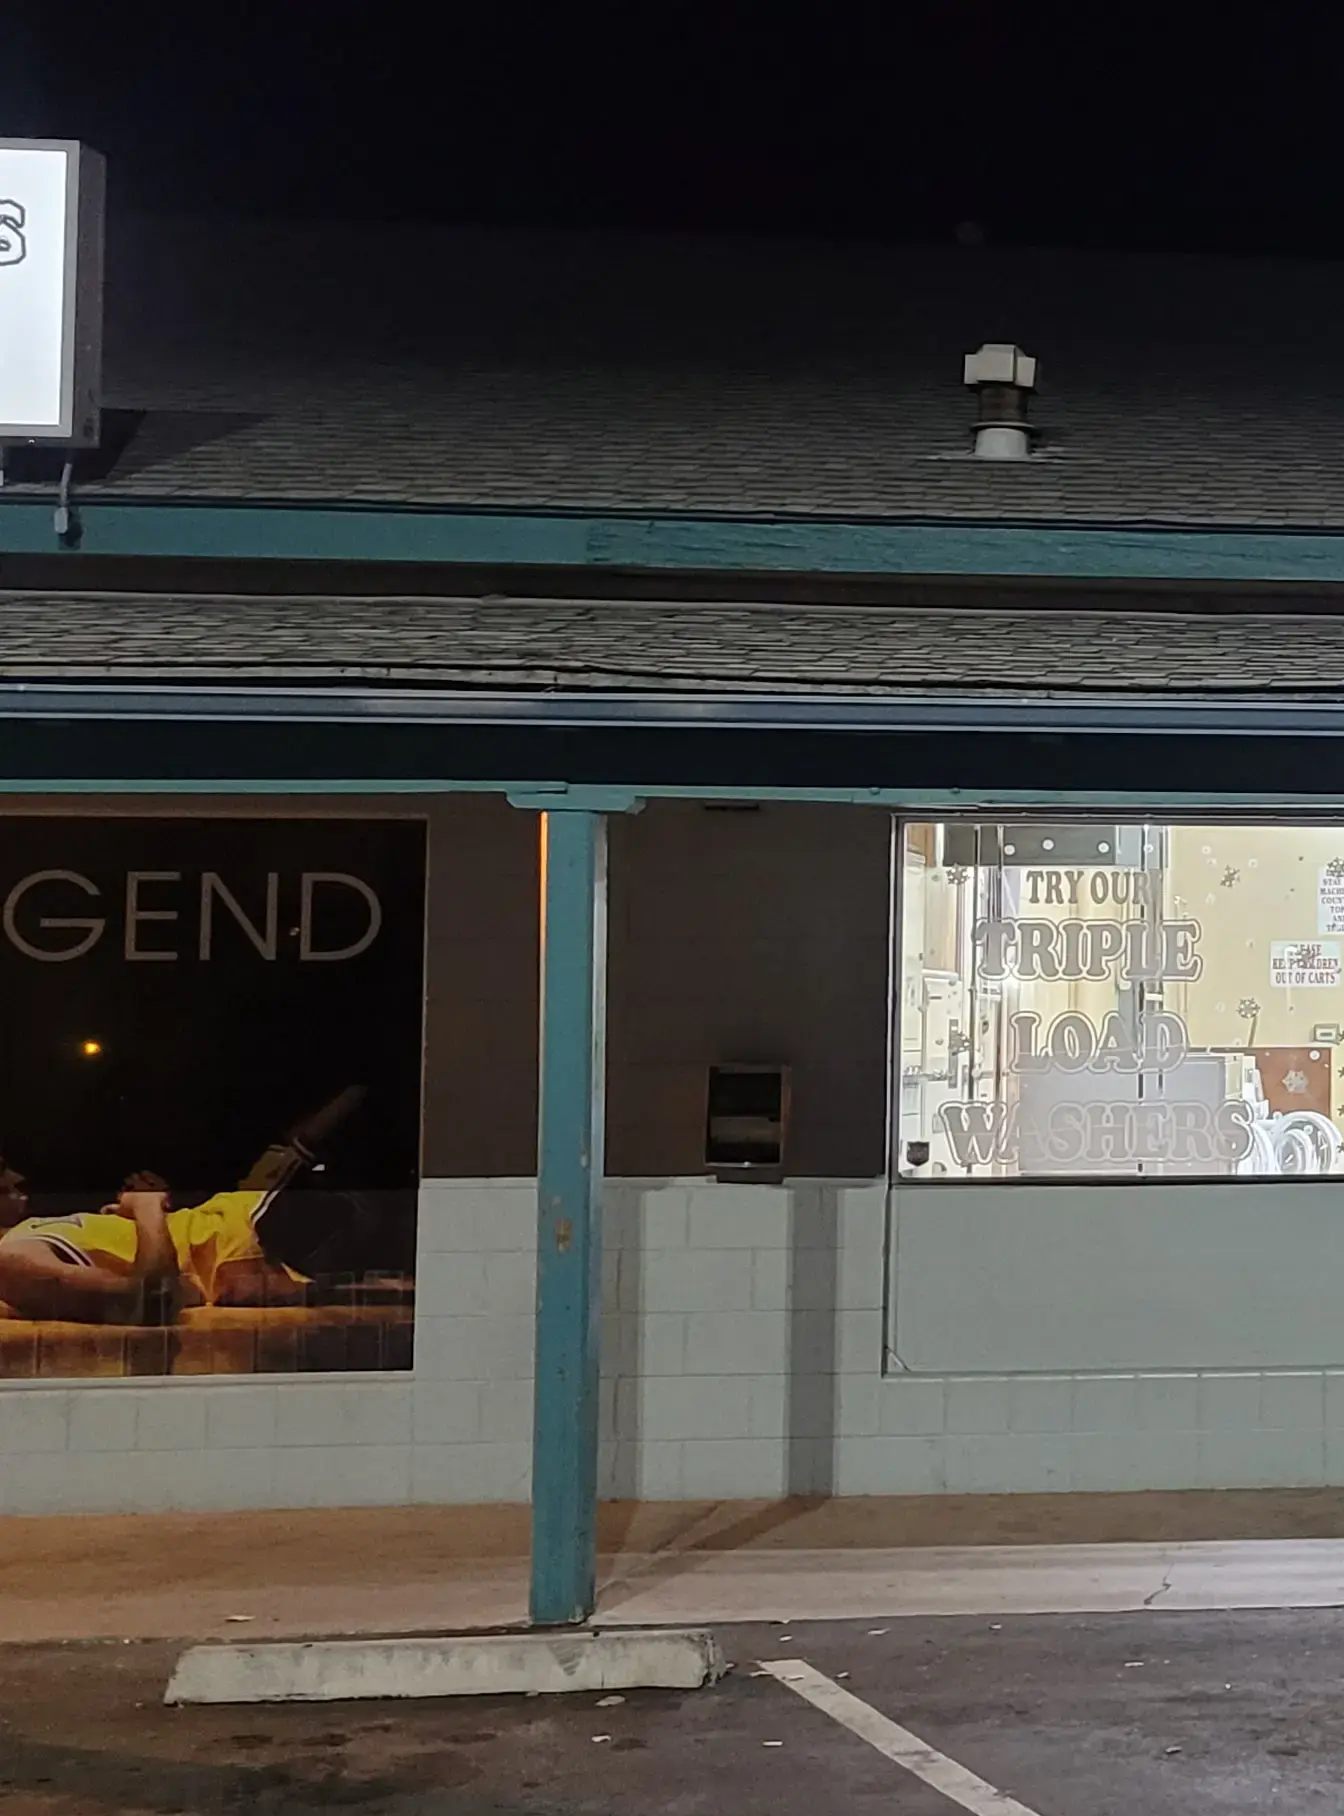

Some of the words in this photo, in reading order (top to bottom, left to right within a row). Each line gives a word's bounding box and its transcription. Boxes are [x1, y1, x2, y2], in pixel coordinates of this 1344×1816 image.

[3, 869, 382, 961] GEND
[1027, 871, 1084, 904] TRY
[1091, 871, 1150, 904] OUR
[973, 918, 1202, 981] TRIPLE
[1276, 972, 1292, 984] OUT
[1295, 972, 1306, 984] OF
[1308, 972, 1335, 984] CARTS
[1010, 1010, 1189, 1074] LOAD
[938, 1100, 1255, 1165] WASHERS
